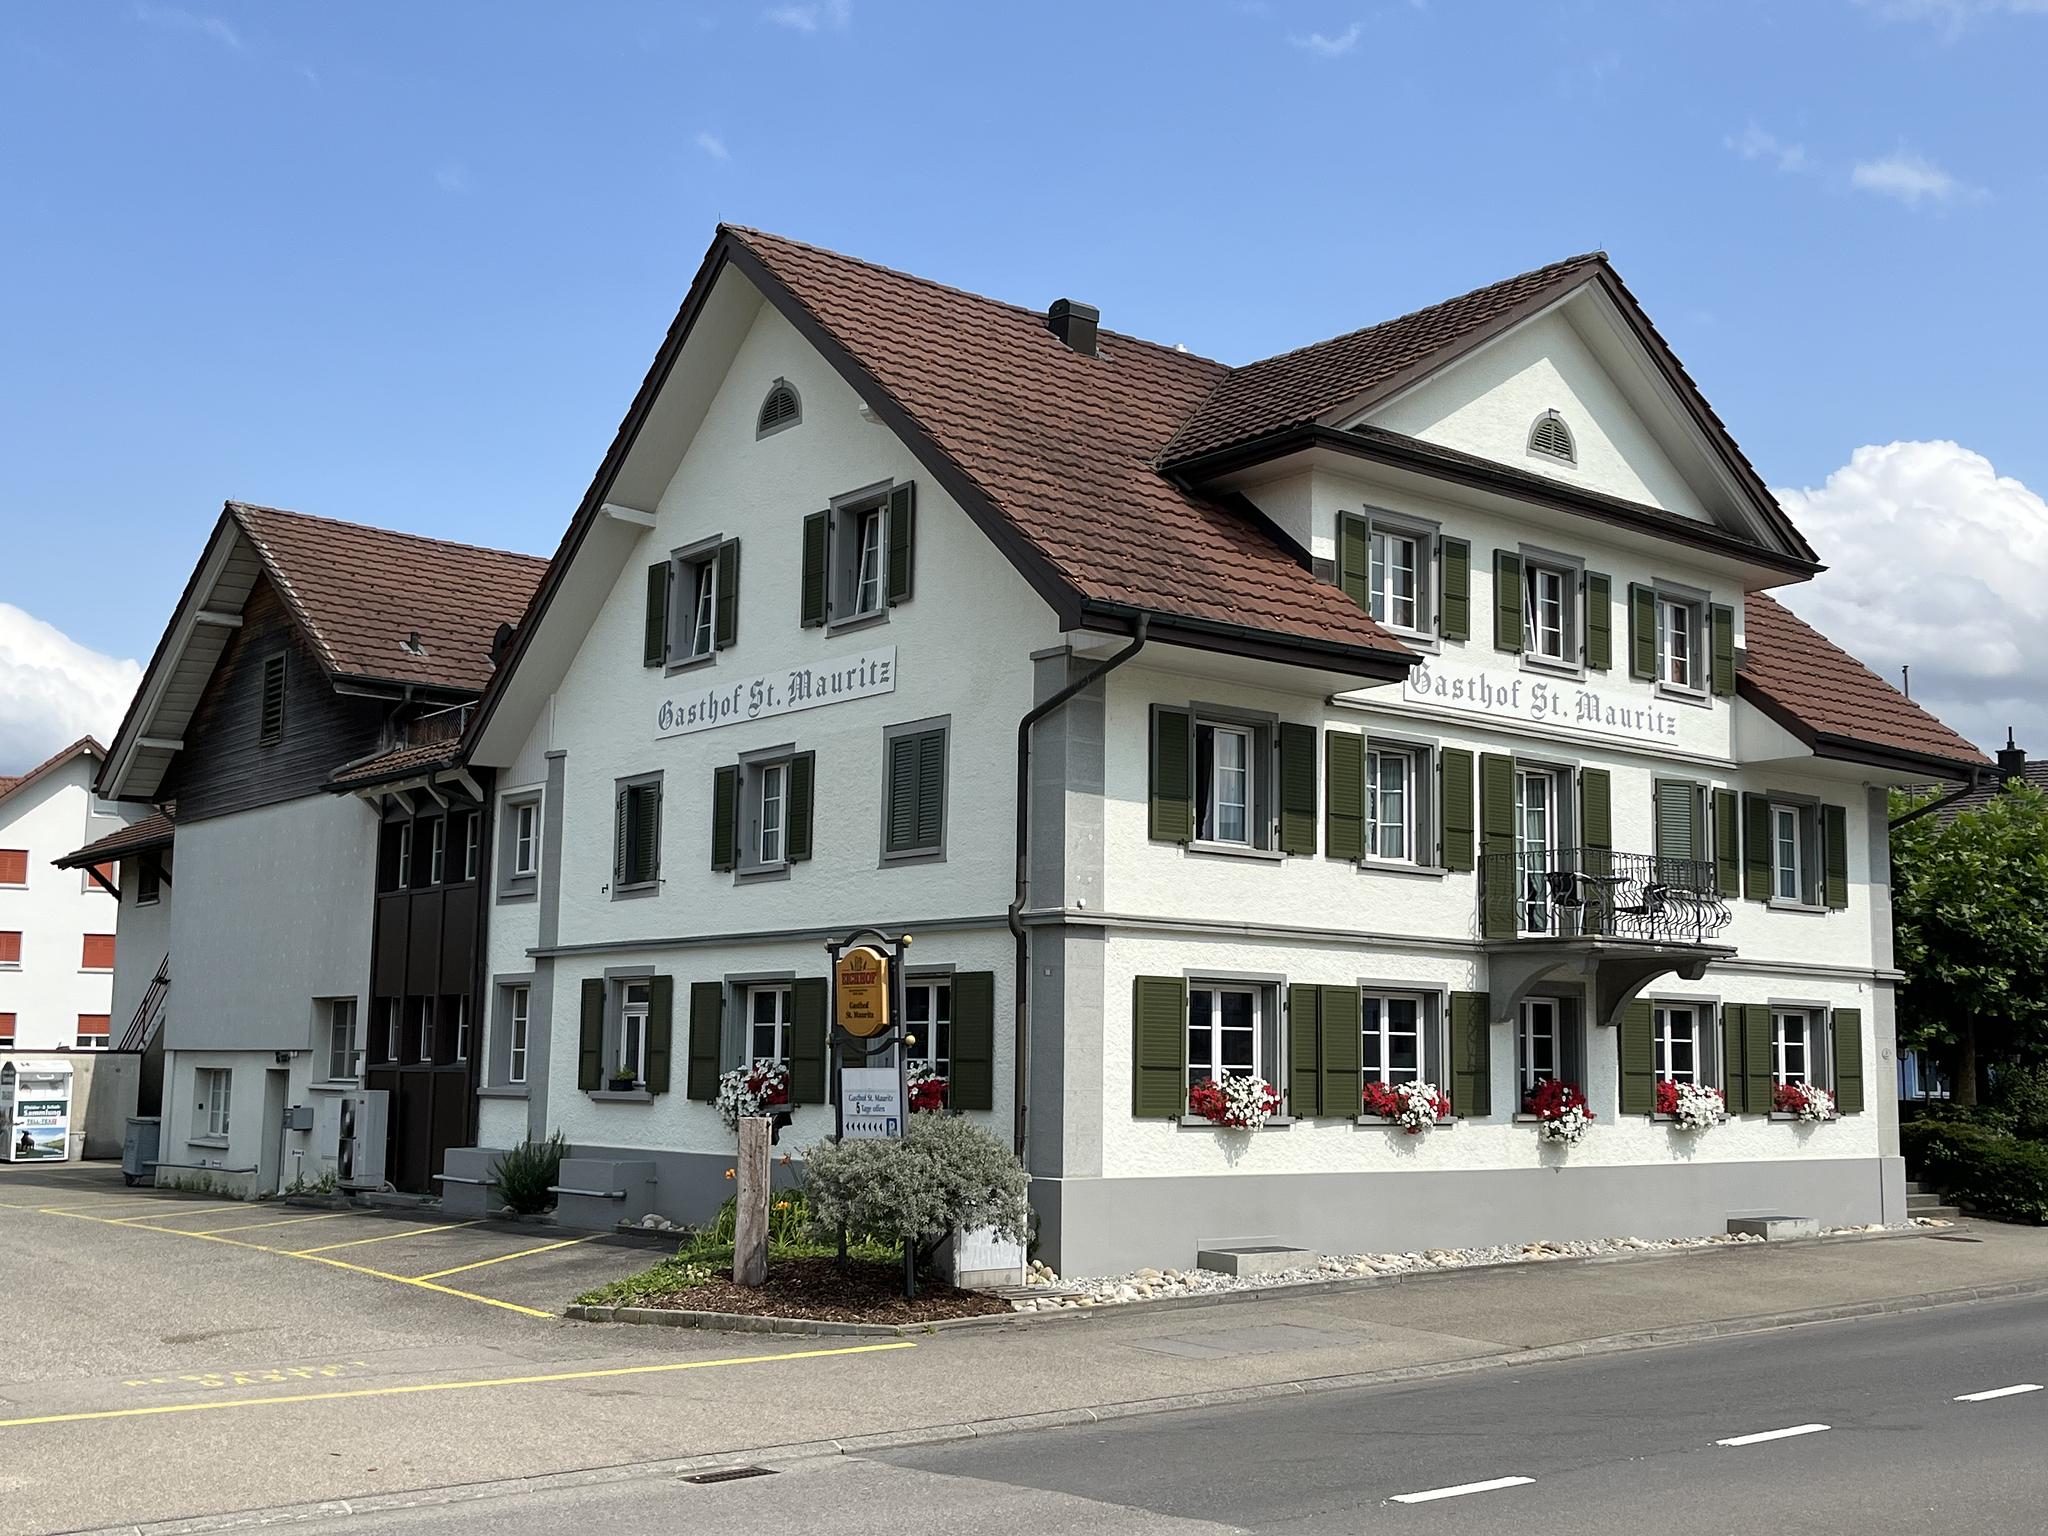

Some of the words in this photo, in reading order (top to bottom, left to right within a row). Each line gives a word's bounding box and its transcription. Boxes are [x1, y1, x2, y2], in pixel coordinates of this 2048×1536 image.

[658, 684, 743, 730] Gasthof
[748, 678, 780, 718] St.
[788, 658, 890, 707] Mauritz
[1410, 662, 1522, 709] Gasthof
[1530, 682, 1568, 720] St.
[1575, 691, 1677, 735] Mauritz
[842, 972, 877, 985] EICHHOF
[849, 1001, 869, 1009] Gasthof
[856, 1102, 860, 1113] 5
